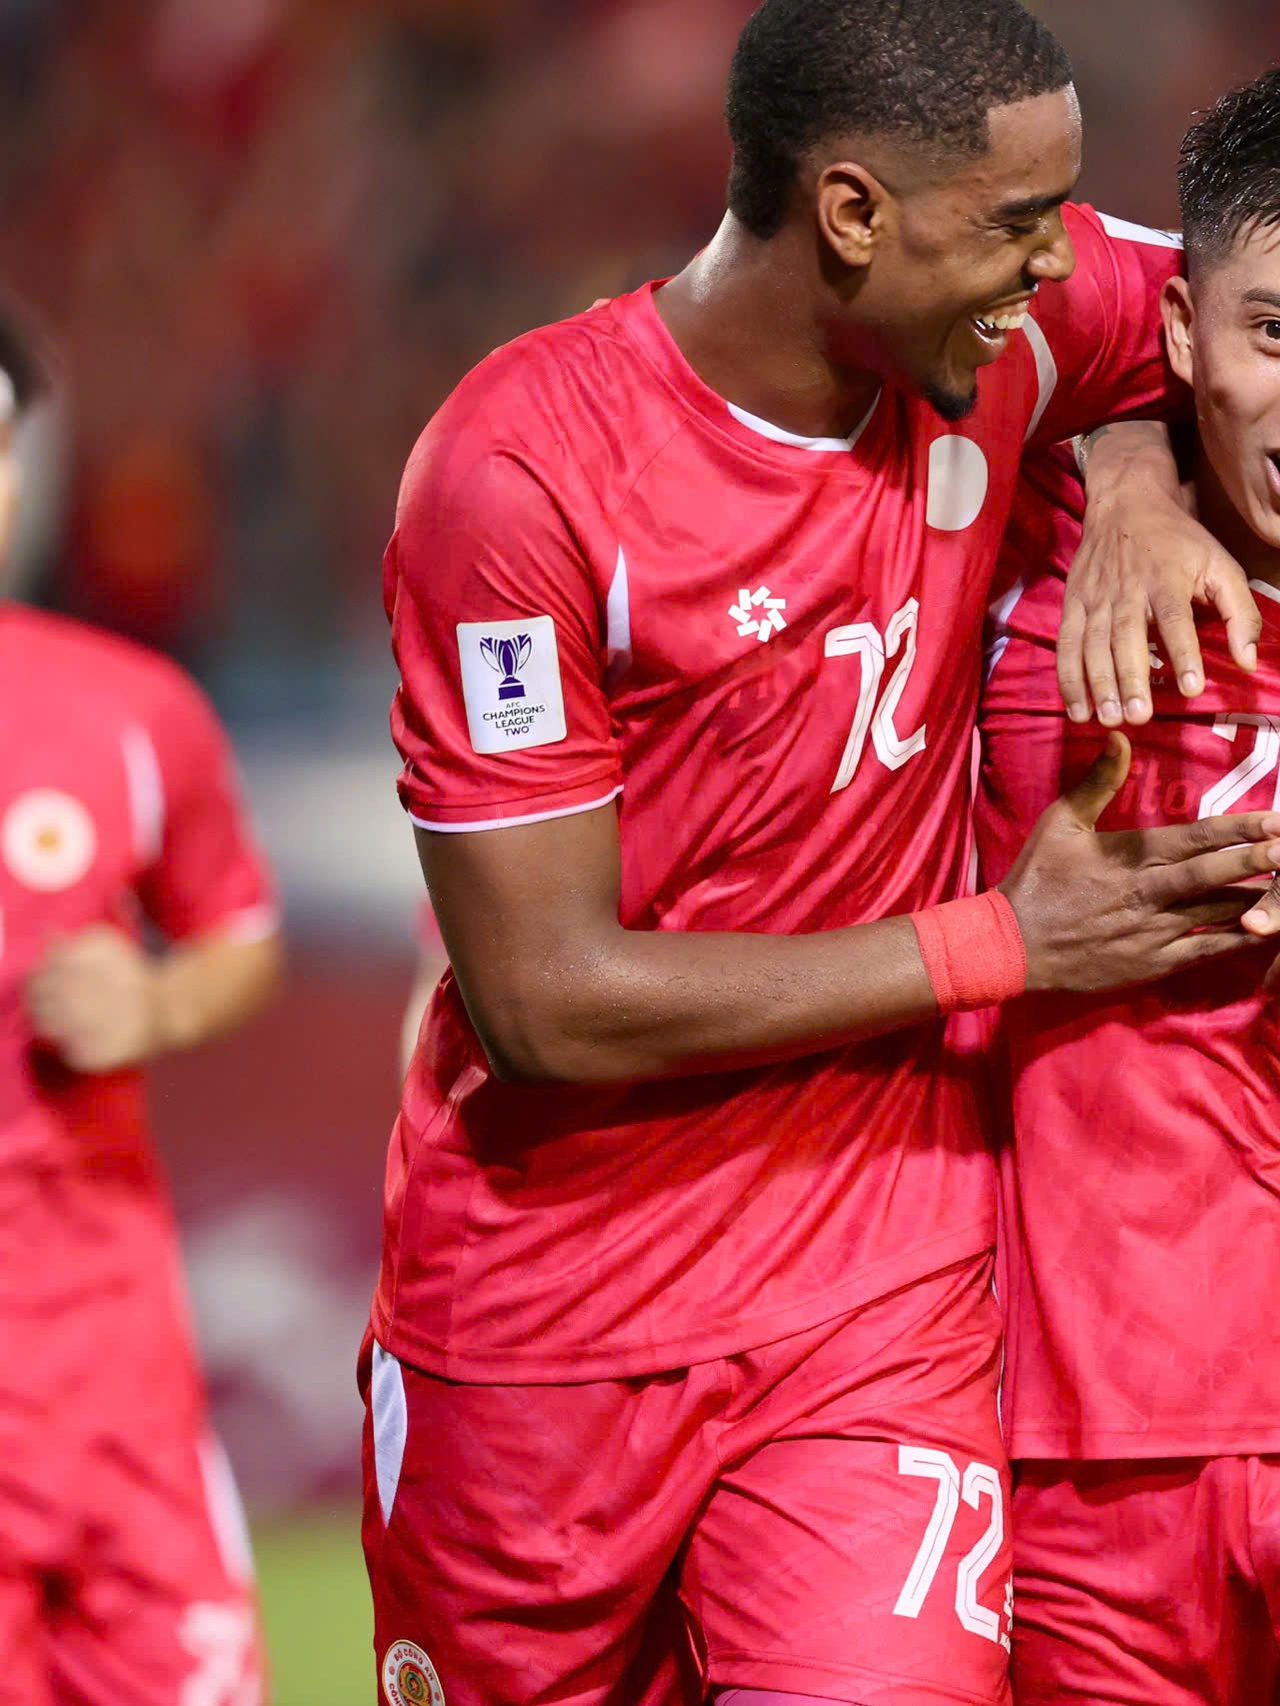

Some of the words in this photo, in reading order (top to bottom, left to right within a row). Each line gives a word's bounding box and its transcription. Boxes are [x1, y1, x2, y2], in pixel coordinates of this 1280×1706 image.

[824, 596, 927, 794] 72
[482, 704, 546, 721] CHAMPIONS
[495, 715, 535, 729] LEAGUE
[504, 726, 529, 736] TWO
[892, 1444, 1004, 1644] 72
